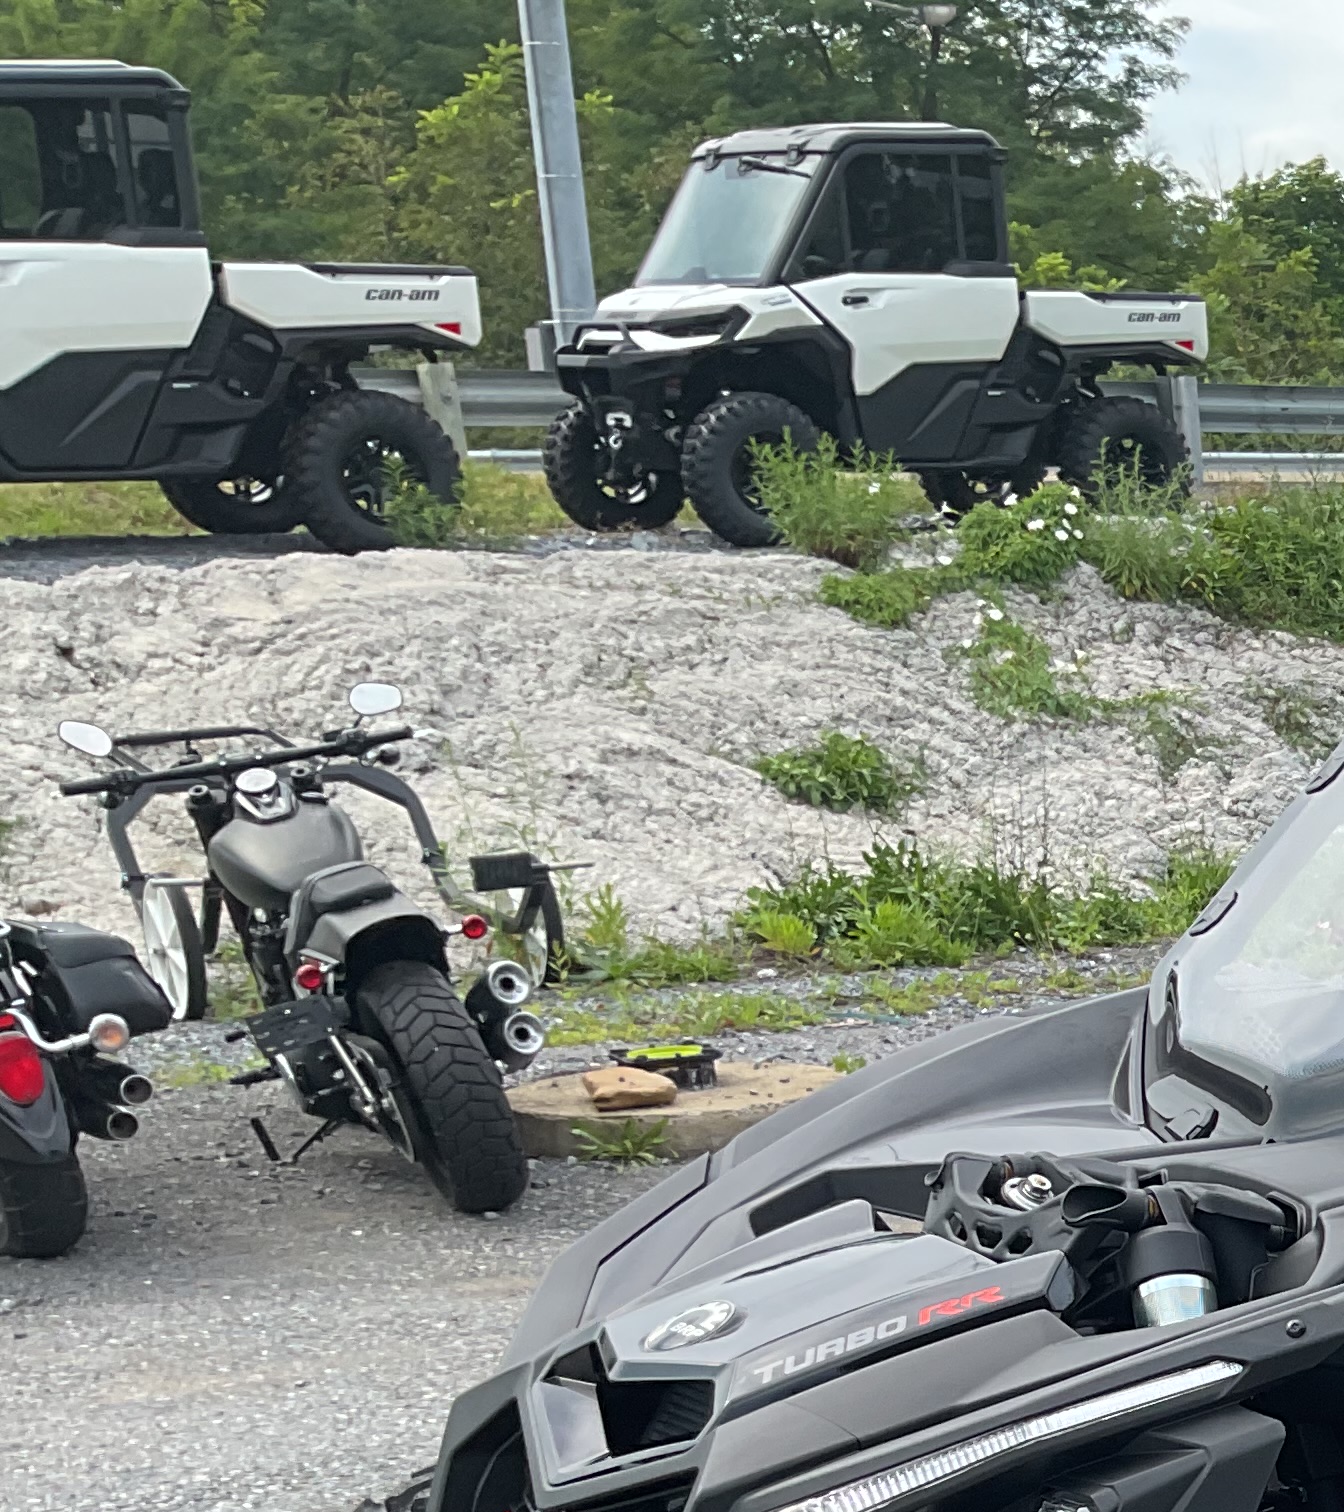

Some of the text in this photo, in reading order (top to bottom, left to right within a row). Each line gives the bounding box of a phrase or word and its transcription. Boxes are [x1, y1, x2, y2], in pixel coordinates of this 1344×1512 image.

[365, 288, 440, 301] can-am
[1127, 312, 1181, 323] can-am
[669, 1321, 705, 1337] BRP
[754, 1285, 1005, 1385] TURBO RR
